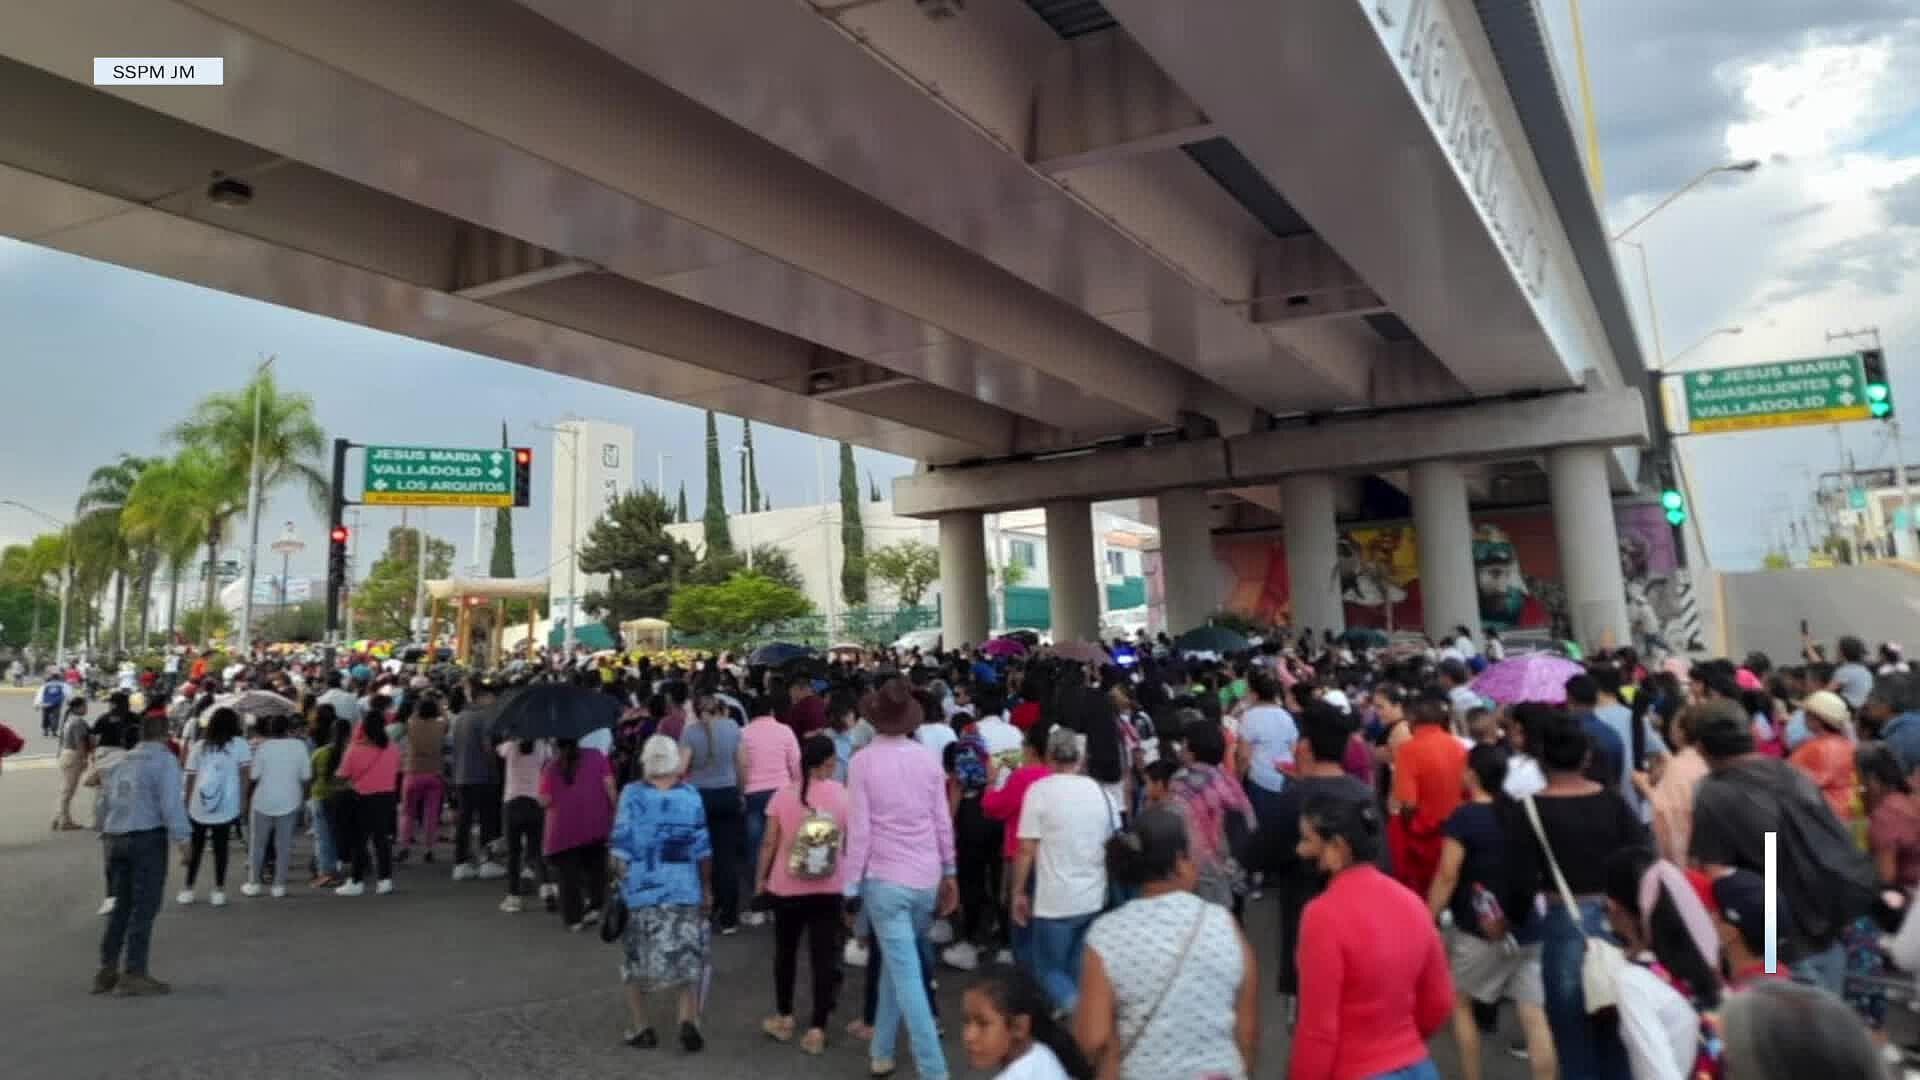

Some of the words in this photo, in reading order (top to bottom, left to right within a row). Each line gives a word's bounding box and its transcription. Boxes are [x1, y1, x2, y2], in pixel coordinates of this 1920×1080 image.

[1722, 366, 1782, 381] JESUS
[1787, 359, 1851, 375] MARIA
[1695, 378, 1830, 401] AGUASCALIENTES
[1697, 395, 1825, 417] VALLADOLID
[372, 449, 426, 461] JESUS
[430, 451, 481, 463] MARIA
[372, 463, 482, 477] VALLADOLID
[398, 479, 427, 490] LOS
[430, 481, 505, 492] ARQUITOS
